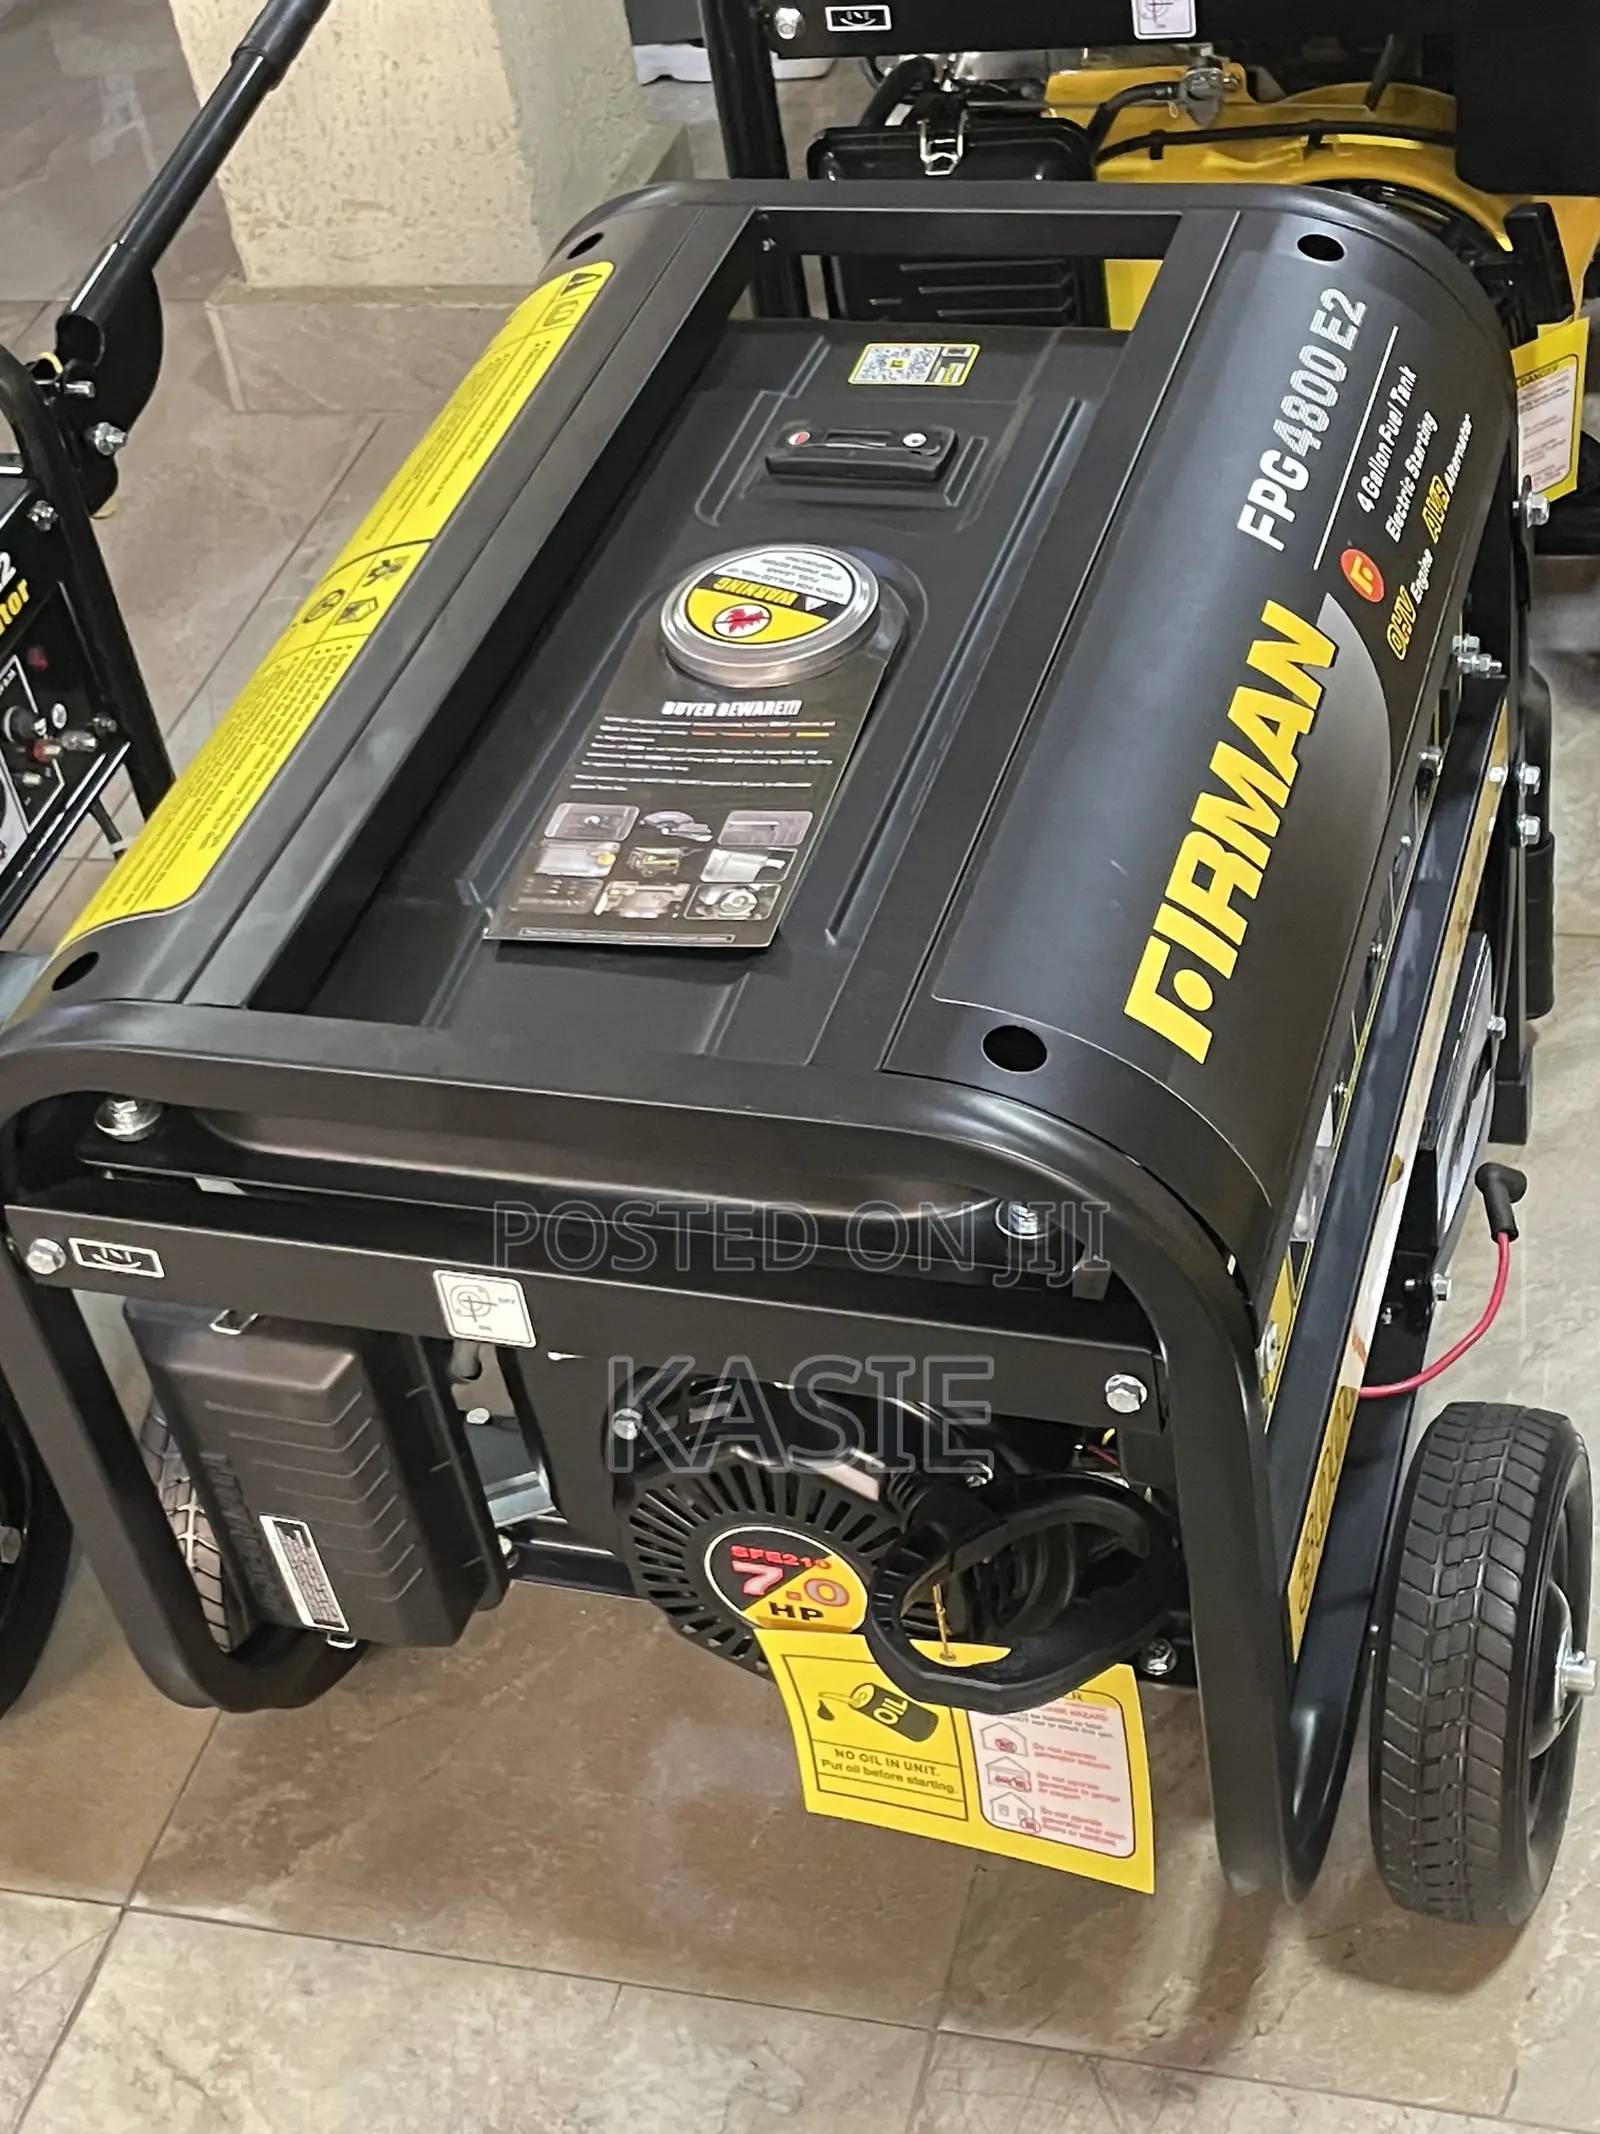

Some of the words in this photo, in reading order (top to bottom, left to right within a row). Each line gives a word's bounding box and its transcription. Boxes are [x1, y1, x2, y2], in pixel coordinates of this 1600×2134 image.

[1309, 288, 1368, 351] E2
[1389, 364, 1418, 411] Tank
[1377, 401, 1404, 454] Fuel
[1360, 440, 1393, 501] Gallon
[1384, 473, 1416, 543] Electric
[1404, 410, 1440, 480] Starting
[1356, 491, 1376, 514] 4
[1385, 583, 1417, 661] OHV
[1409, 547, 1434, 605] Engine
[1443, 412, 1474, 496] Alternator
[712, 577, 800, 607] WARNING
[661, 701, 716, 717] BUYER
[716, 700, 802, 717] BEWARE!!!
[1122, 599, 1337, 1065] FIRMAN
[769, 1600, 825, 1621] HP
[873, 1697, 908, 1725] OIL
[821, 1758, 843, 1771] Put
[845, 1763, 861, 1774] oil
[863, 1766, 904, 1783] before
[834, 1748, 855, 1761] NO
[859, 1753, 882, 1766] OIL
[885, 1757, 900, 1770] IN
